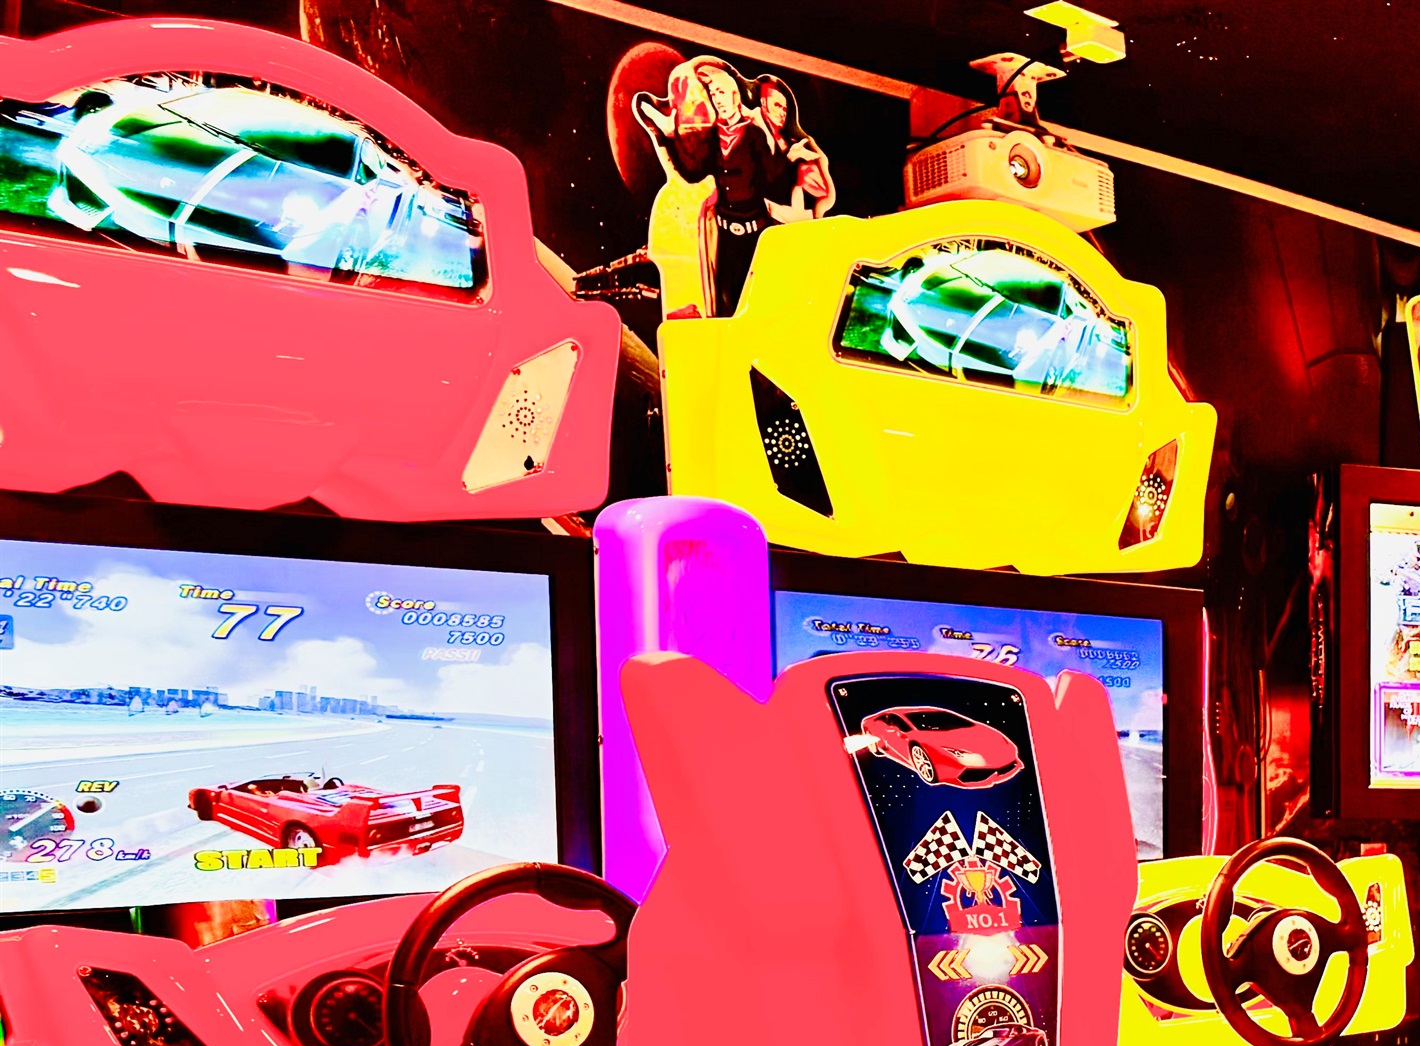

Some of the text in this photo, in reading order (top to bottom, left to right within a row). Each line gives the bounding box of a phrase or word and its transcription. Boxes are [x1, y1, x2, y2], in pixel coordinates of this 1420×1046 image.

[34, 576, 93, 593] Time
[179, 584, 234, 600] Time
[376, 595, 436, 611] Score
[212, 603, 304, 641] 77
[401, 611, 505, 628] 0008585
[856, 623, 891, 635] Time
[940, 628, 974, 640] Time
[447, 631, 506, 647] 7500
[1055, 636, 1091, 647] Score
[76, 780, 119, 792] REV
[194, 847, 322, 871] START
[965, 911, 1009, 929] NO.1
